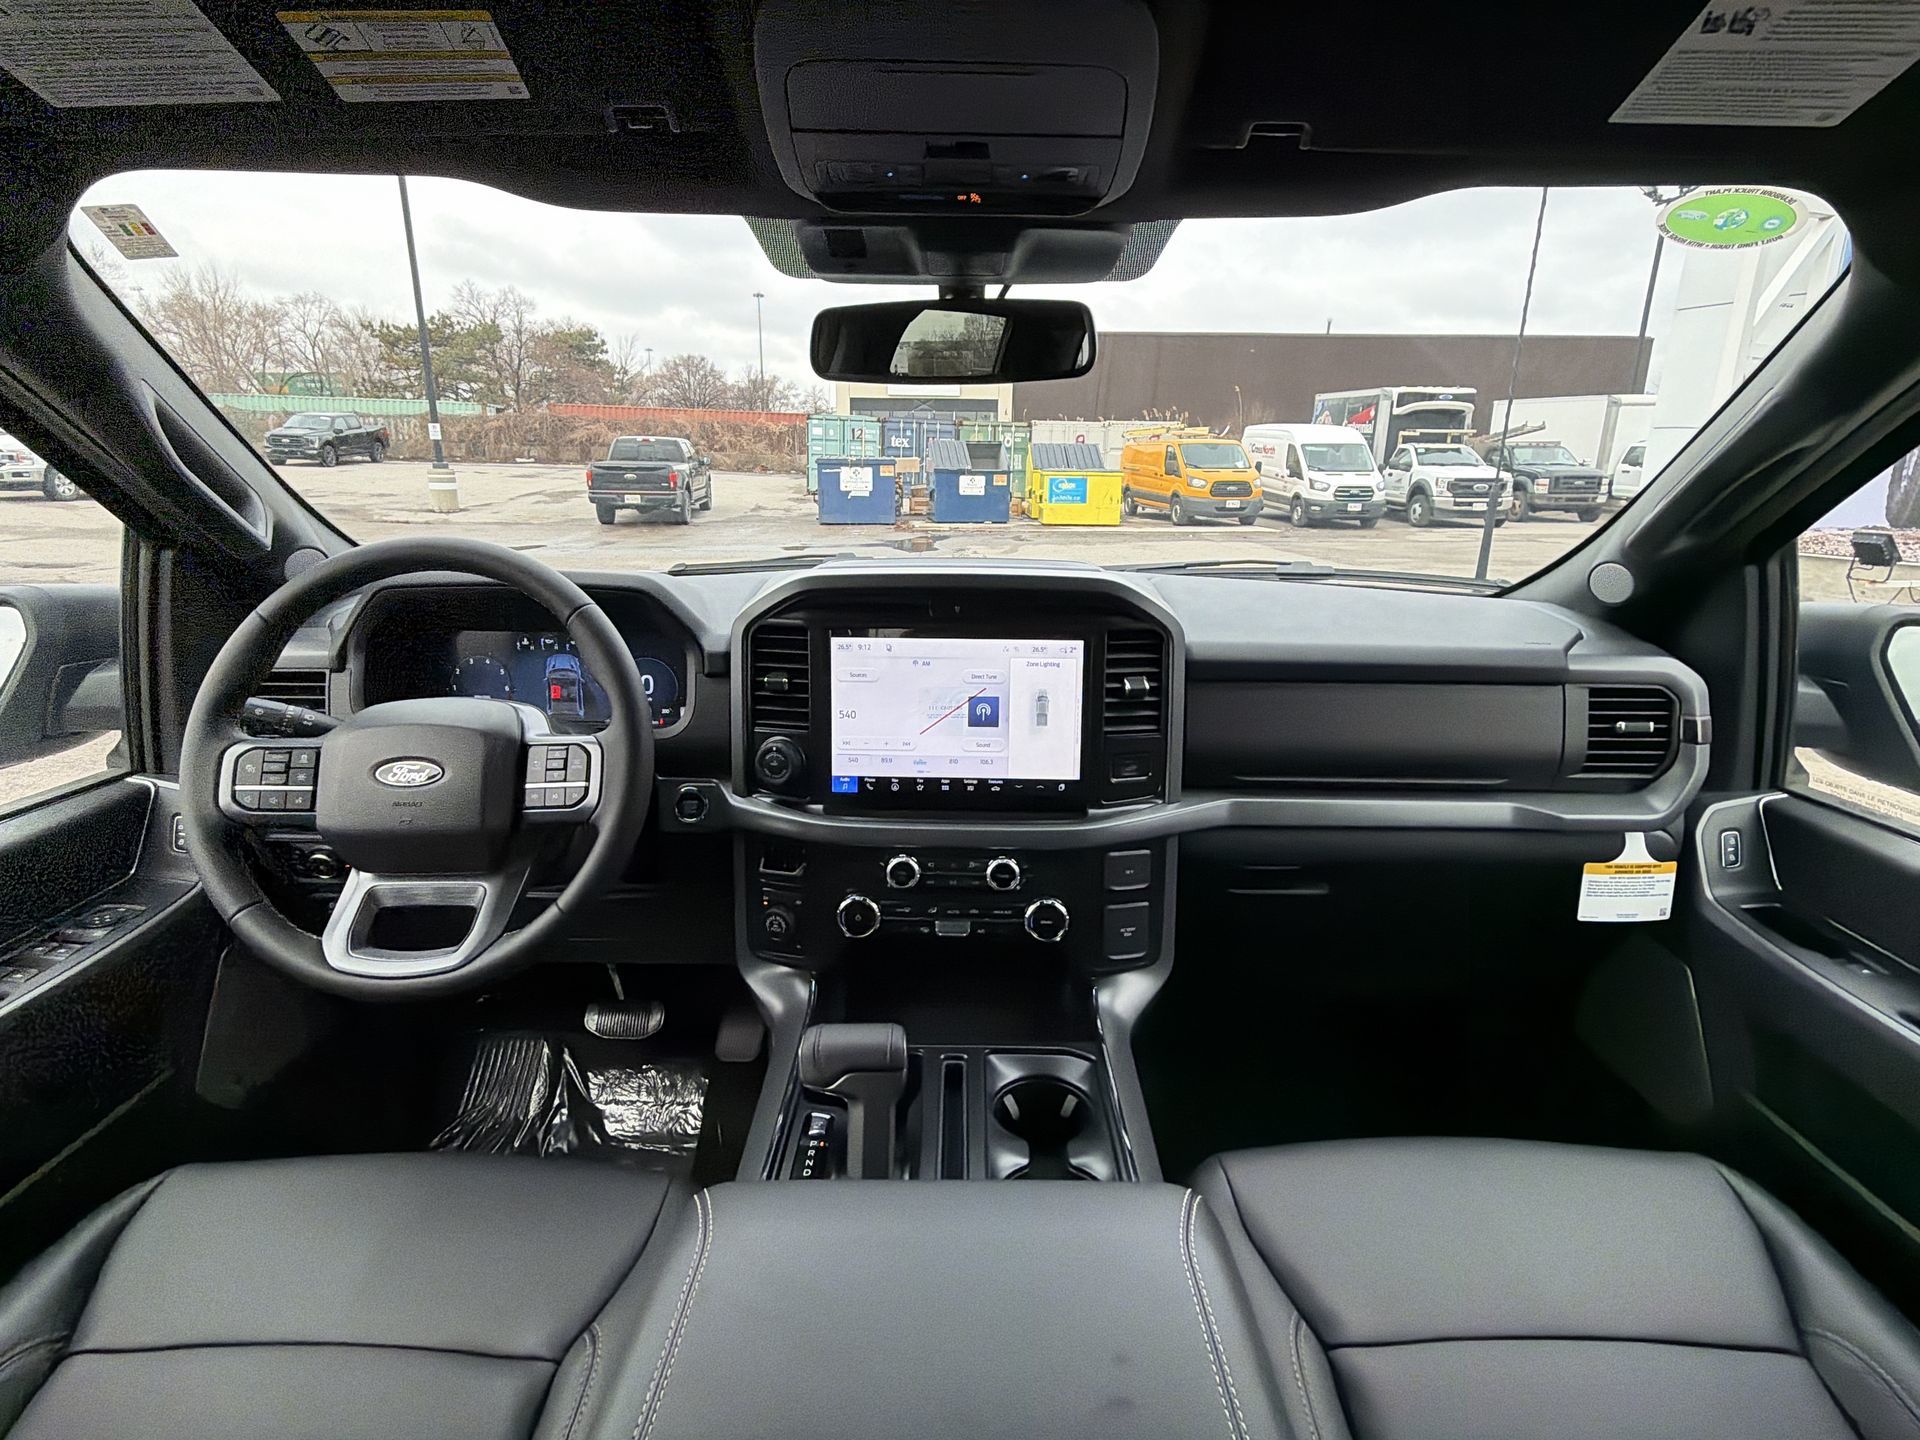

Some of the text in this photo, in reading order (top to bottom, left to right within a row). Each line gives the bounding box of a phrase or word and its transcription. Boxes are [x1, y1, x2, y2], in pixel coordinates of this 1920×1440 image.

[851, 428, 863, 440] 12
[890, 434, 910, 448] tex
[858, 643, 872, 651] 9:12
[1039, 661, 1061, 669] Lighting
[839, 710, 857, 720] 540
[388, 764, 430, 781] Ford
[1849, 788, 1866, 799] DANS
[802, 1168, 812, 1176] D
